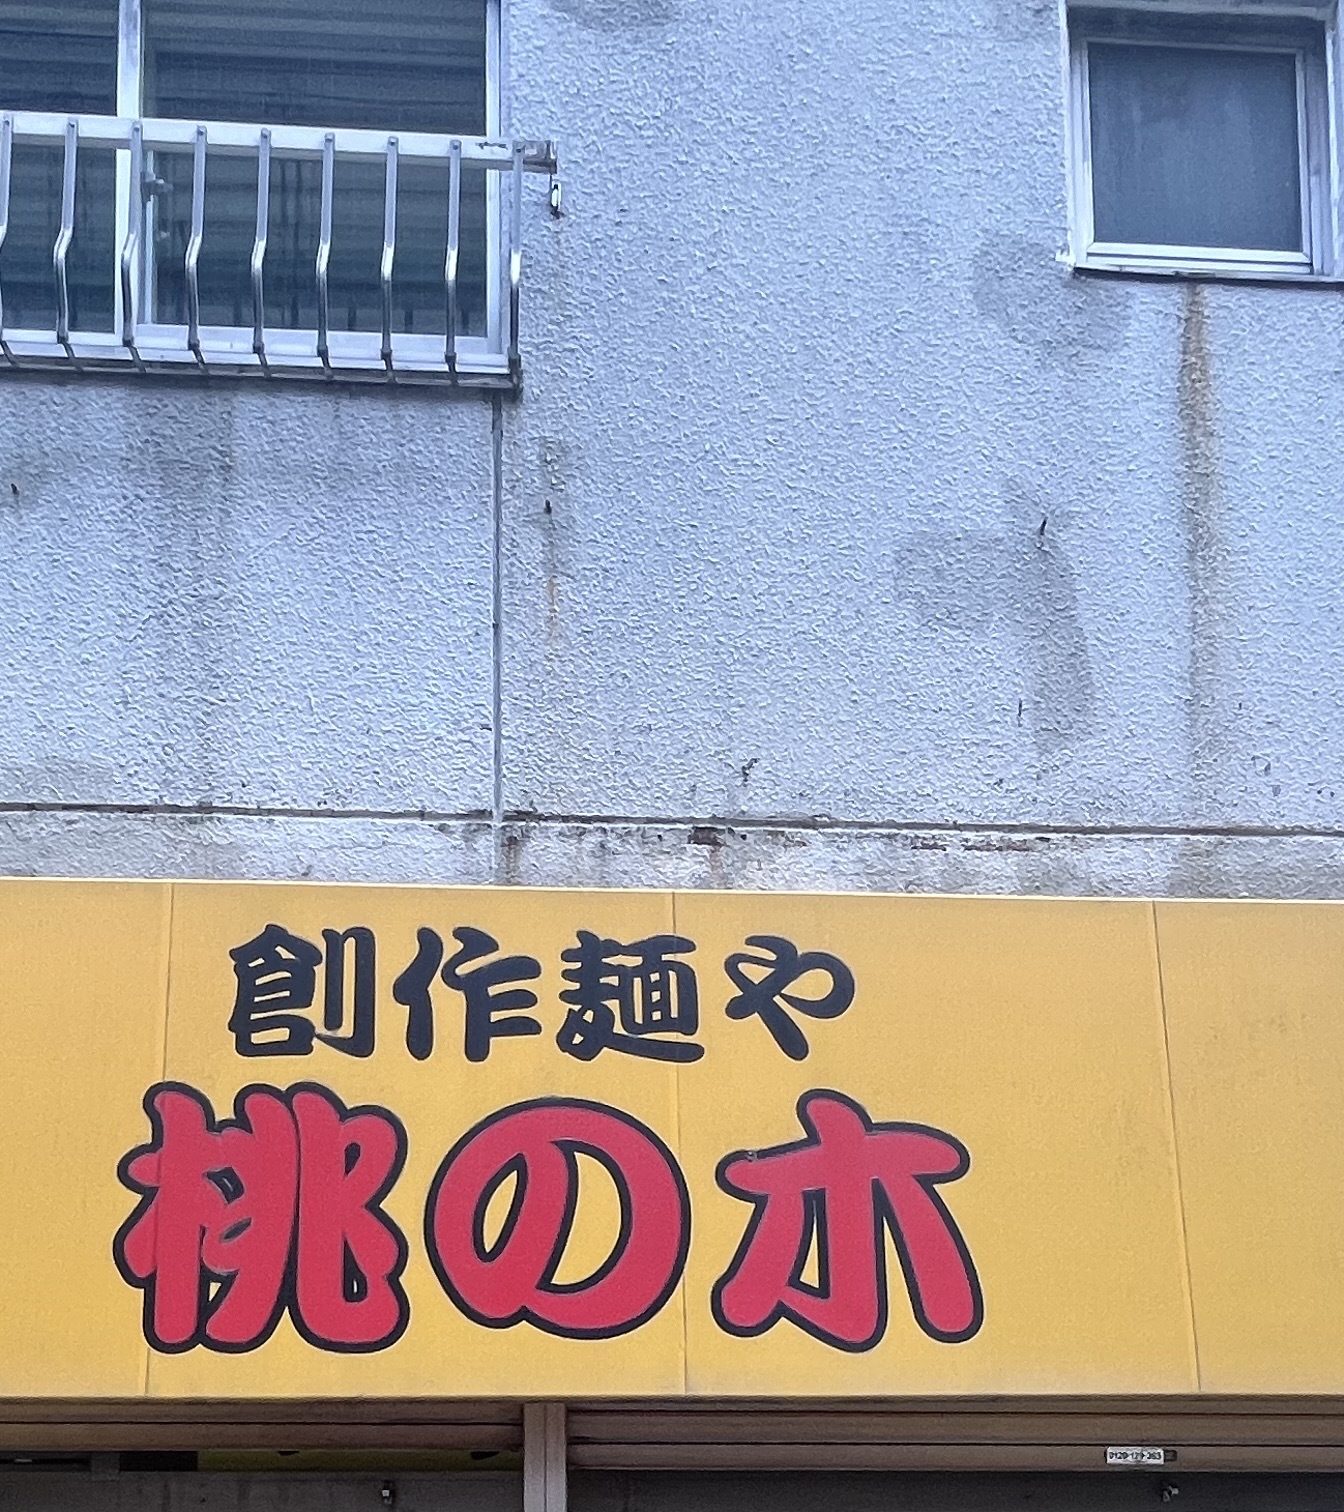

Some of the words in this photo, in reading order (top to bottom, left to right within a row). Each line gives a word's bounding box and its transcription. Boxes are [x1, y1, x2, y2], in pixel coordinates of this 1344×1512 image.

[227, 924, 855, 1061] 創作麺や
[113, 1081, 984, 1352] 桃の木
